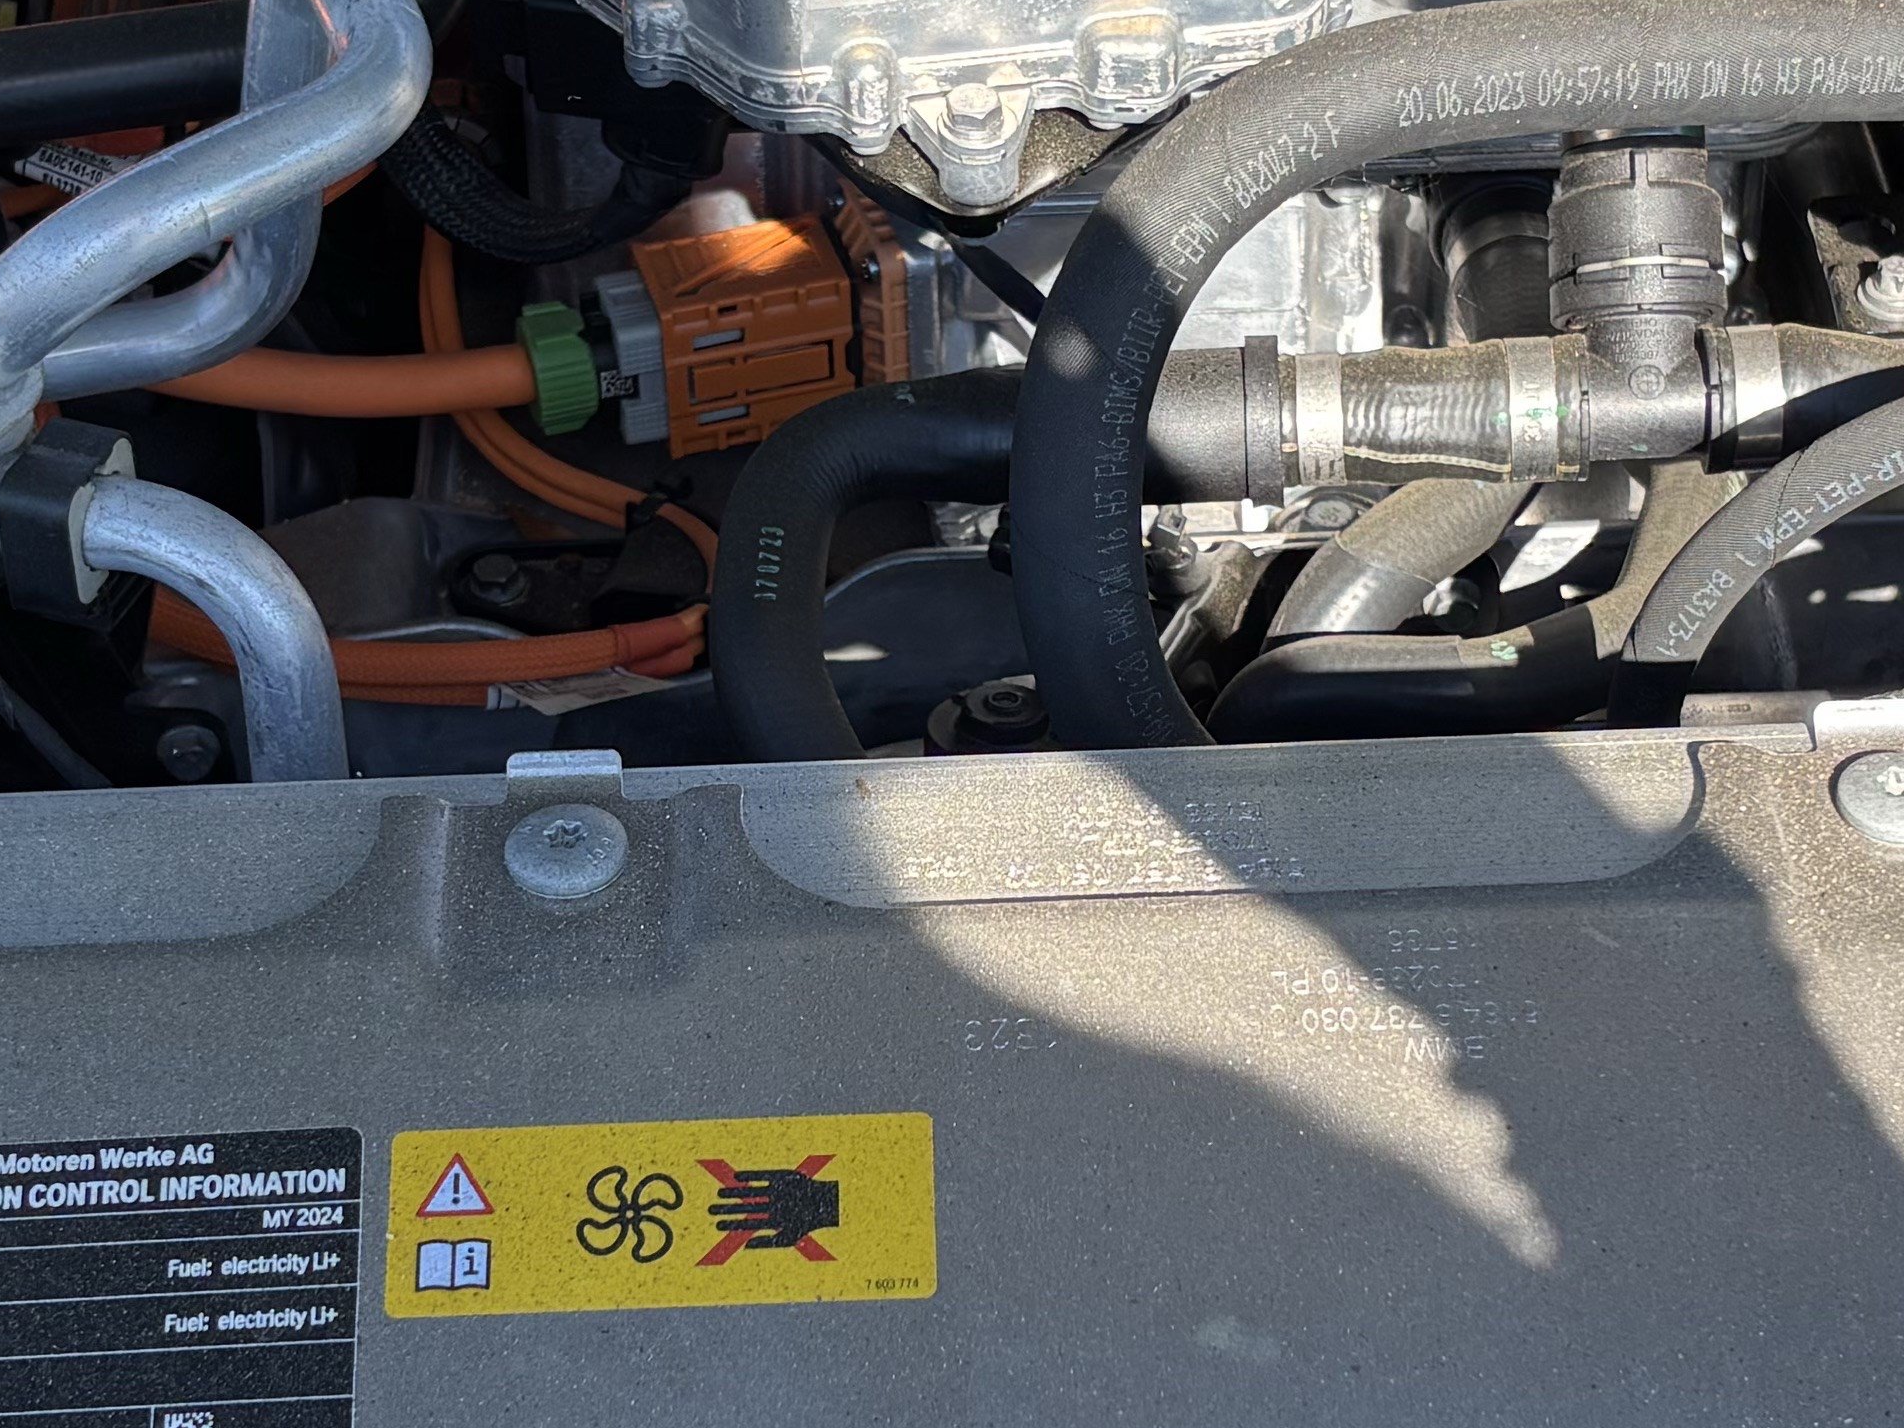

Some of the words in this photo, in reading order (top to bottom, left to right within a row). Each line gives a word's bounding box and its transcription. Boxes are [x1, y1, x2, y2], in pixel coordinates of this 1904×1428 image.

[1398, 72, 1525, 127] 20.06.2023
[1538, 62, 1639, 107] 09:57:19
[1301, 1006, 1356, 1033] 030
[1369, 1005, 1425, 1030] 737
[1404, 1035, 1487, 1063] BMW
[100, 1146, 175, 1170] Werke
[180, 1144, 214, 1166] AG
[29, 1179, 155, 1209] CONTROL
[160, 1168, 346, 1203] INFORMATION
[262, 1209, 293, 1229] MY
[296, 1205, 344, 1228] 2024
[167, 1256, 214, 1278] Fuel:
[221, 1252, 308, 1277] electricity
[312, 1249, 341, 1272] Li+
[865, 1279, 871, 1290] 7
[899, 1278, 919, 1289] 774
[165, 1312, 210, 1334] Fuel:
[217, 1306, 305, 1333] electricity
[309, 1305, 339, 1327] Li+
